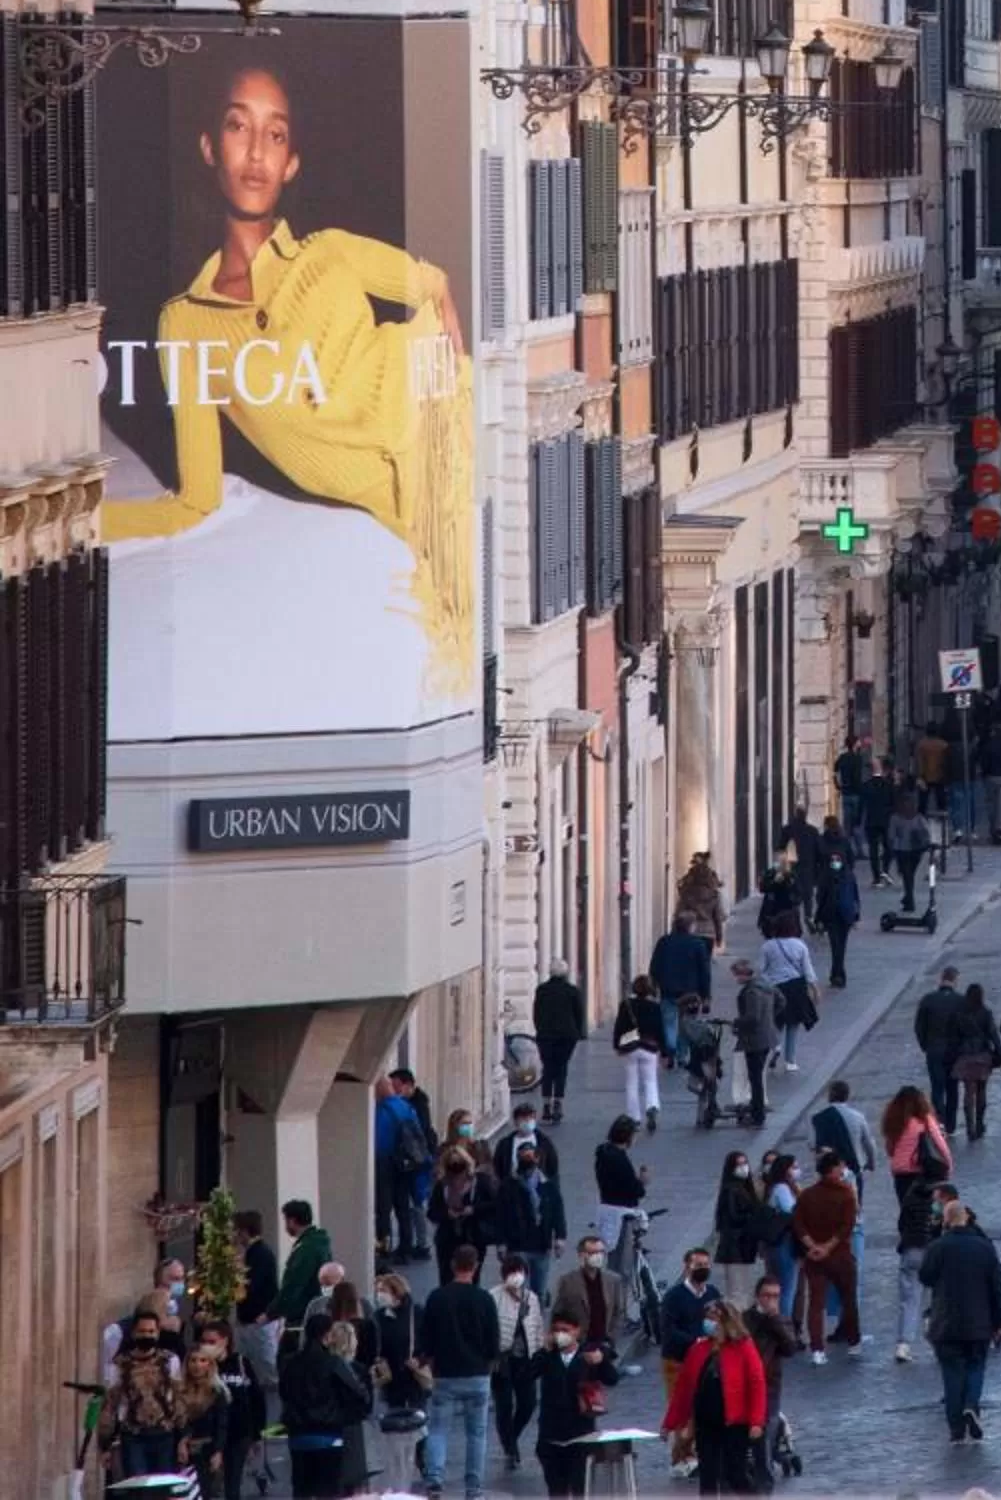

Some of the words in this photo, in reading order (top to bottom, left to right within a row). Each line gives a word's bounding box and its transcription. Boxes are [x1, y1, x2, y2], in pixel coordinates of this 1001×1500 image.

[98, 339, 327, 406] TTEGA
[209, 806, 301, 839] URBAN
[311, 802, 402, 834] VISION
